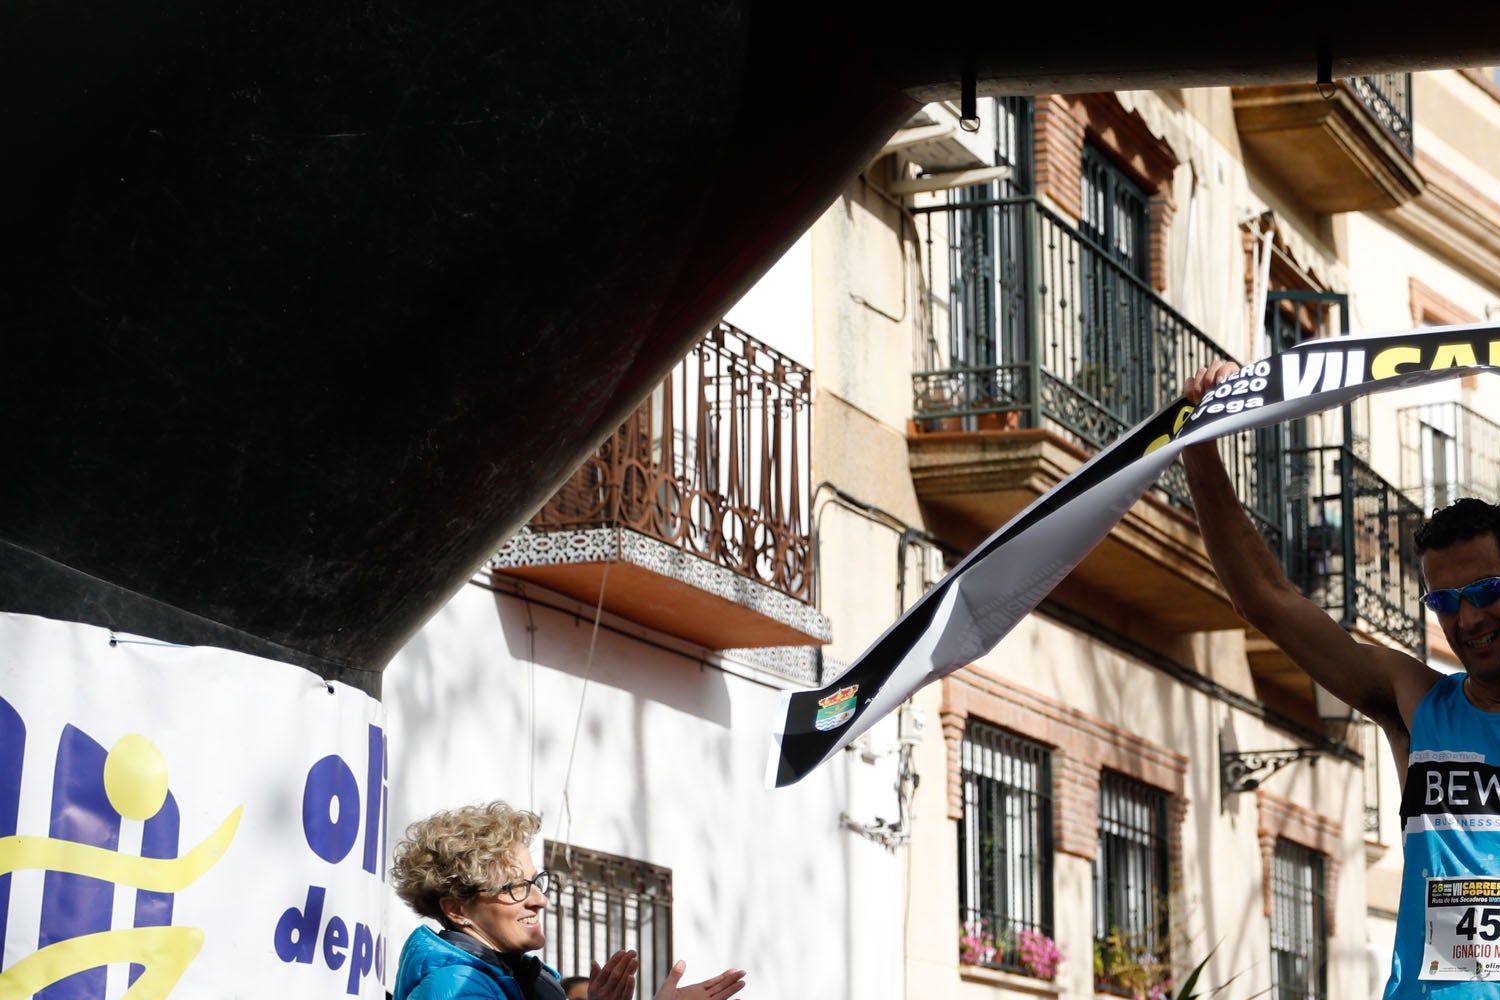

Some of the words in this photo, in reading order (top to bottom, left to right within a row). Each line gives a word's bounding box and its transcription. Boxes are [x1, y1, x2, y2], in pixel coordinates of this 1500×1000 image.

[1281, 350, 1366, 401] VII
[1200, 377, 1268, 407] 2020
[1452, 944, 1491, 959] IGNACIO
